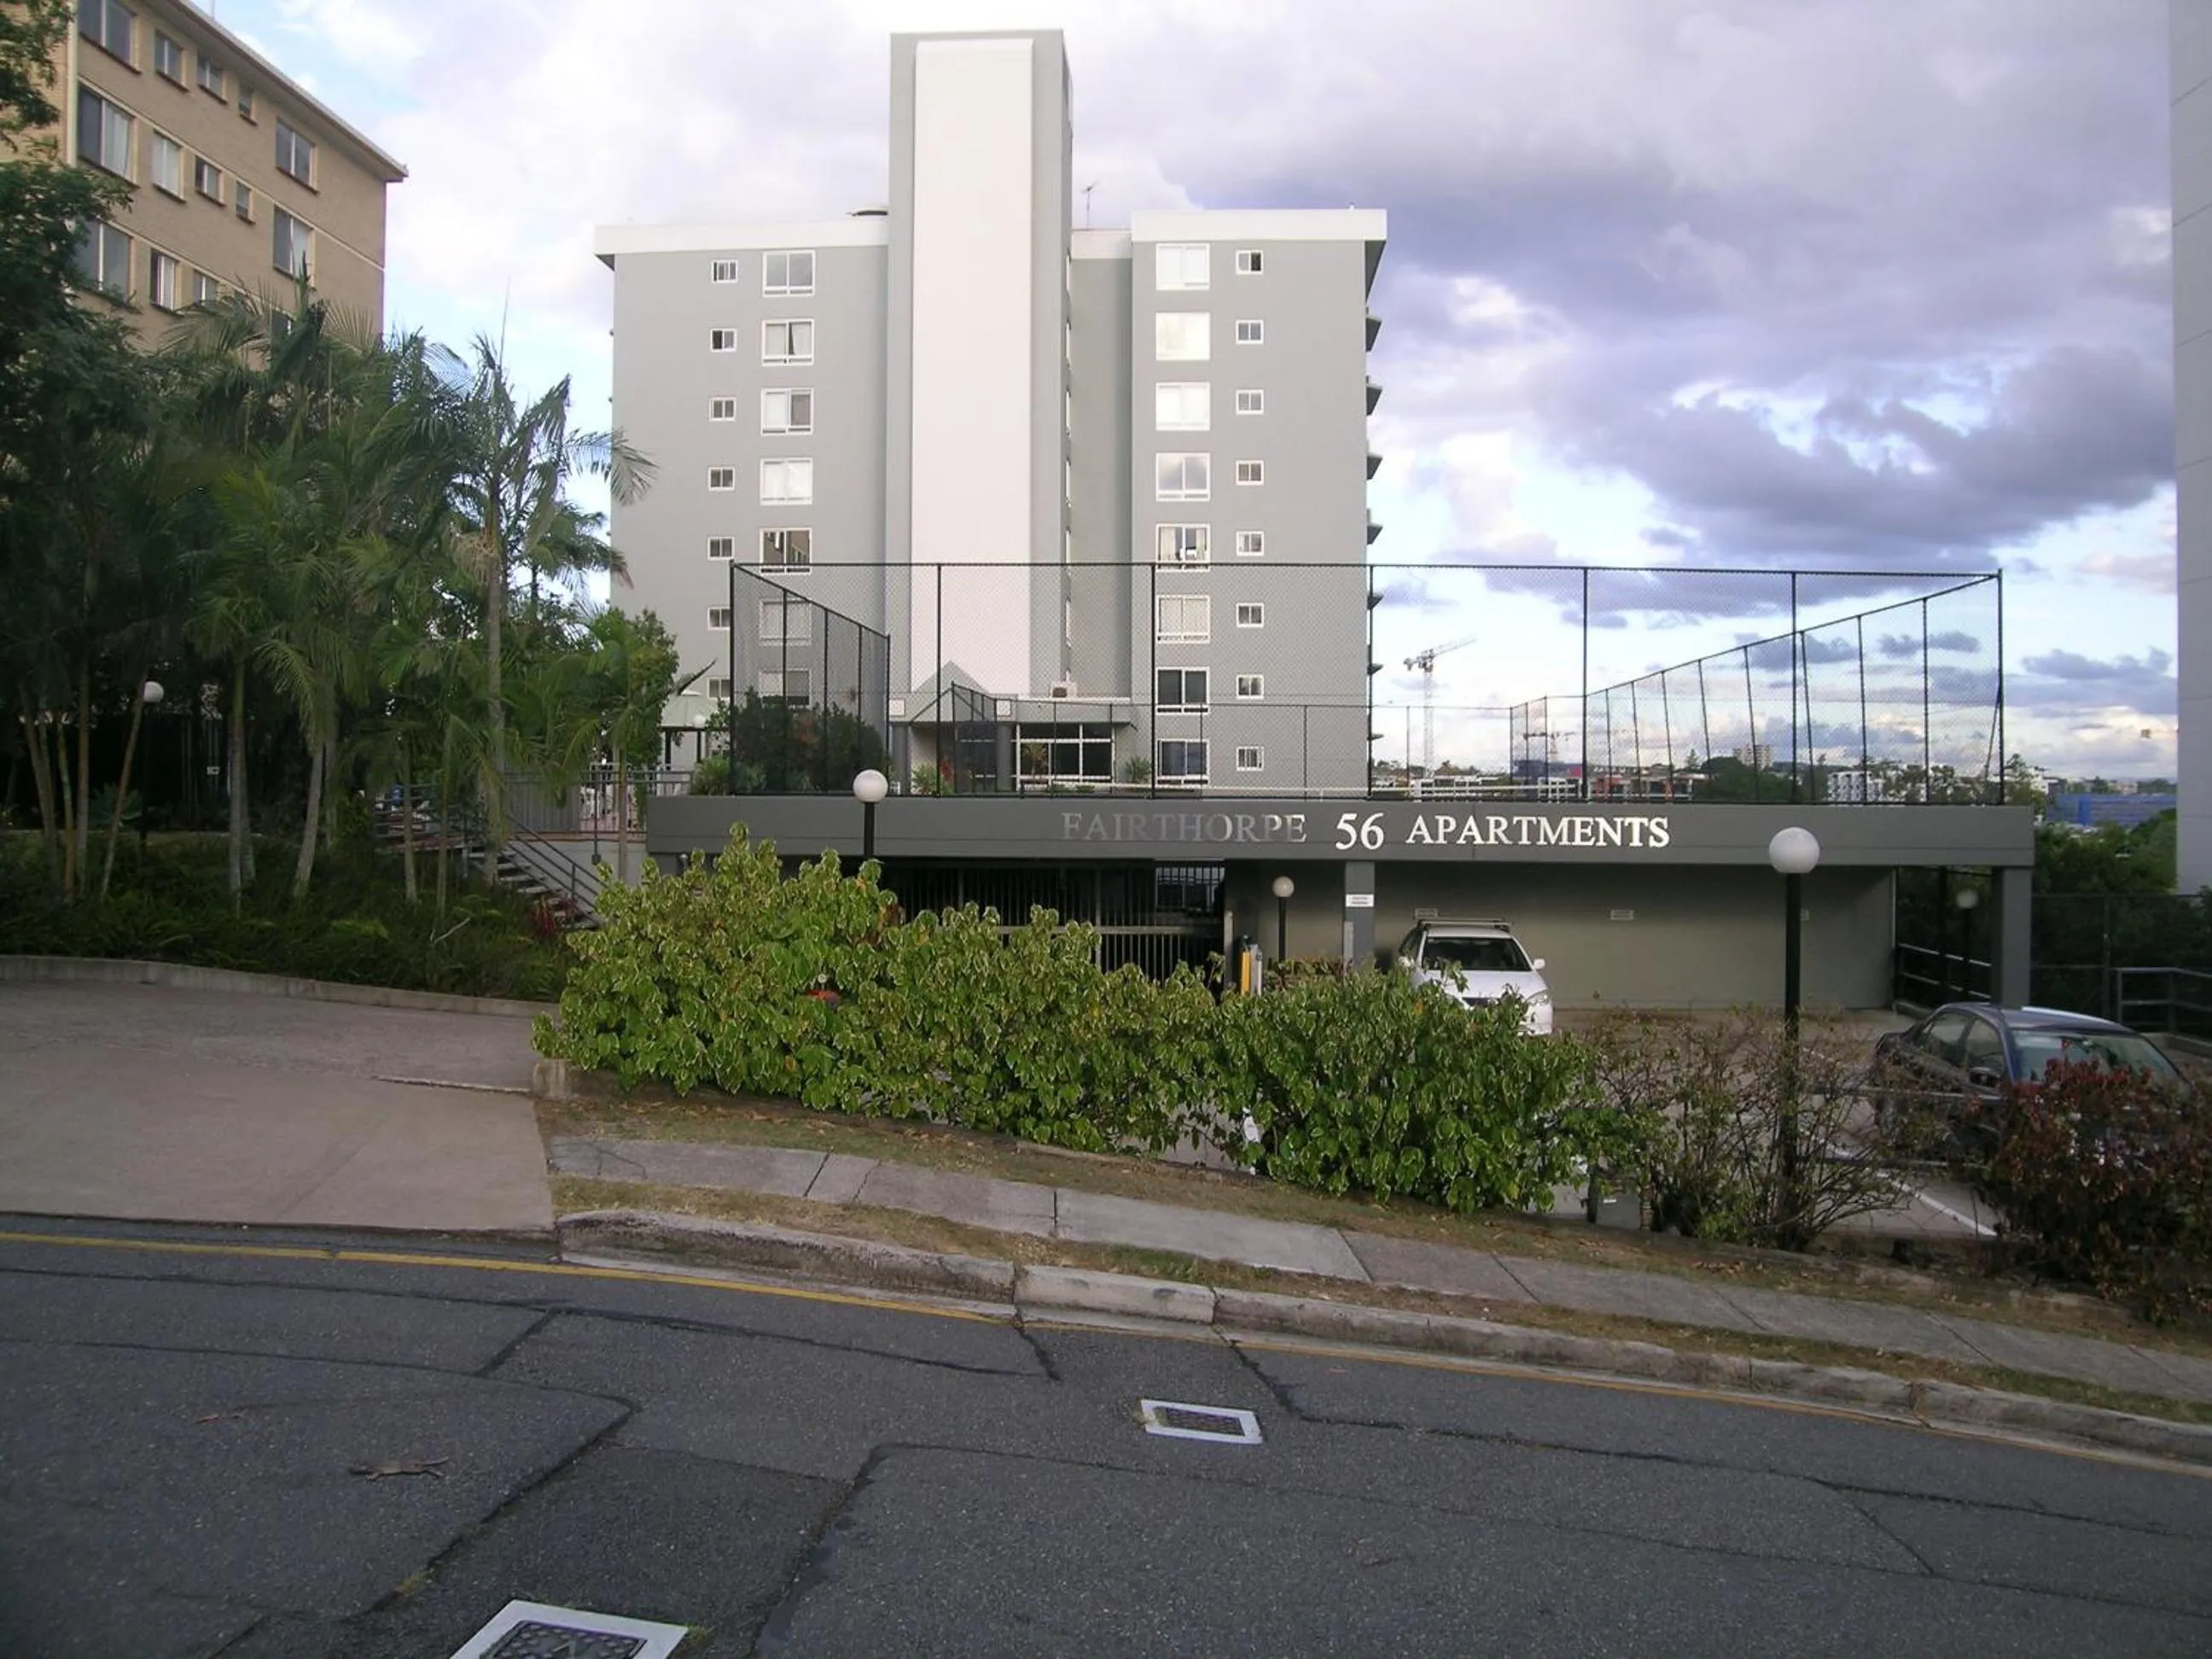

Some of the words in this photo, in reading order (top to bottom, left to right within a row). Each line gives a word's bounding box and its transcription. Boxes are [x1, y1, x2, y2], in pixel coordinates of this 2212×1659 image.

[1062, 812, 1307, 843] FAIRTHORPE
[1335, 812, 1385, 850] 56
[1406, 814, 1670, 847] APARTMENTS
